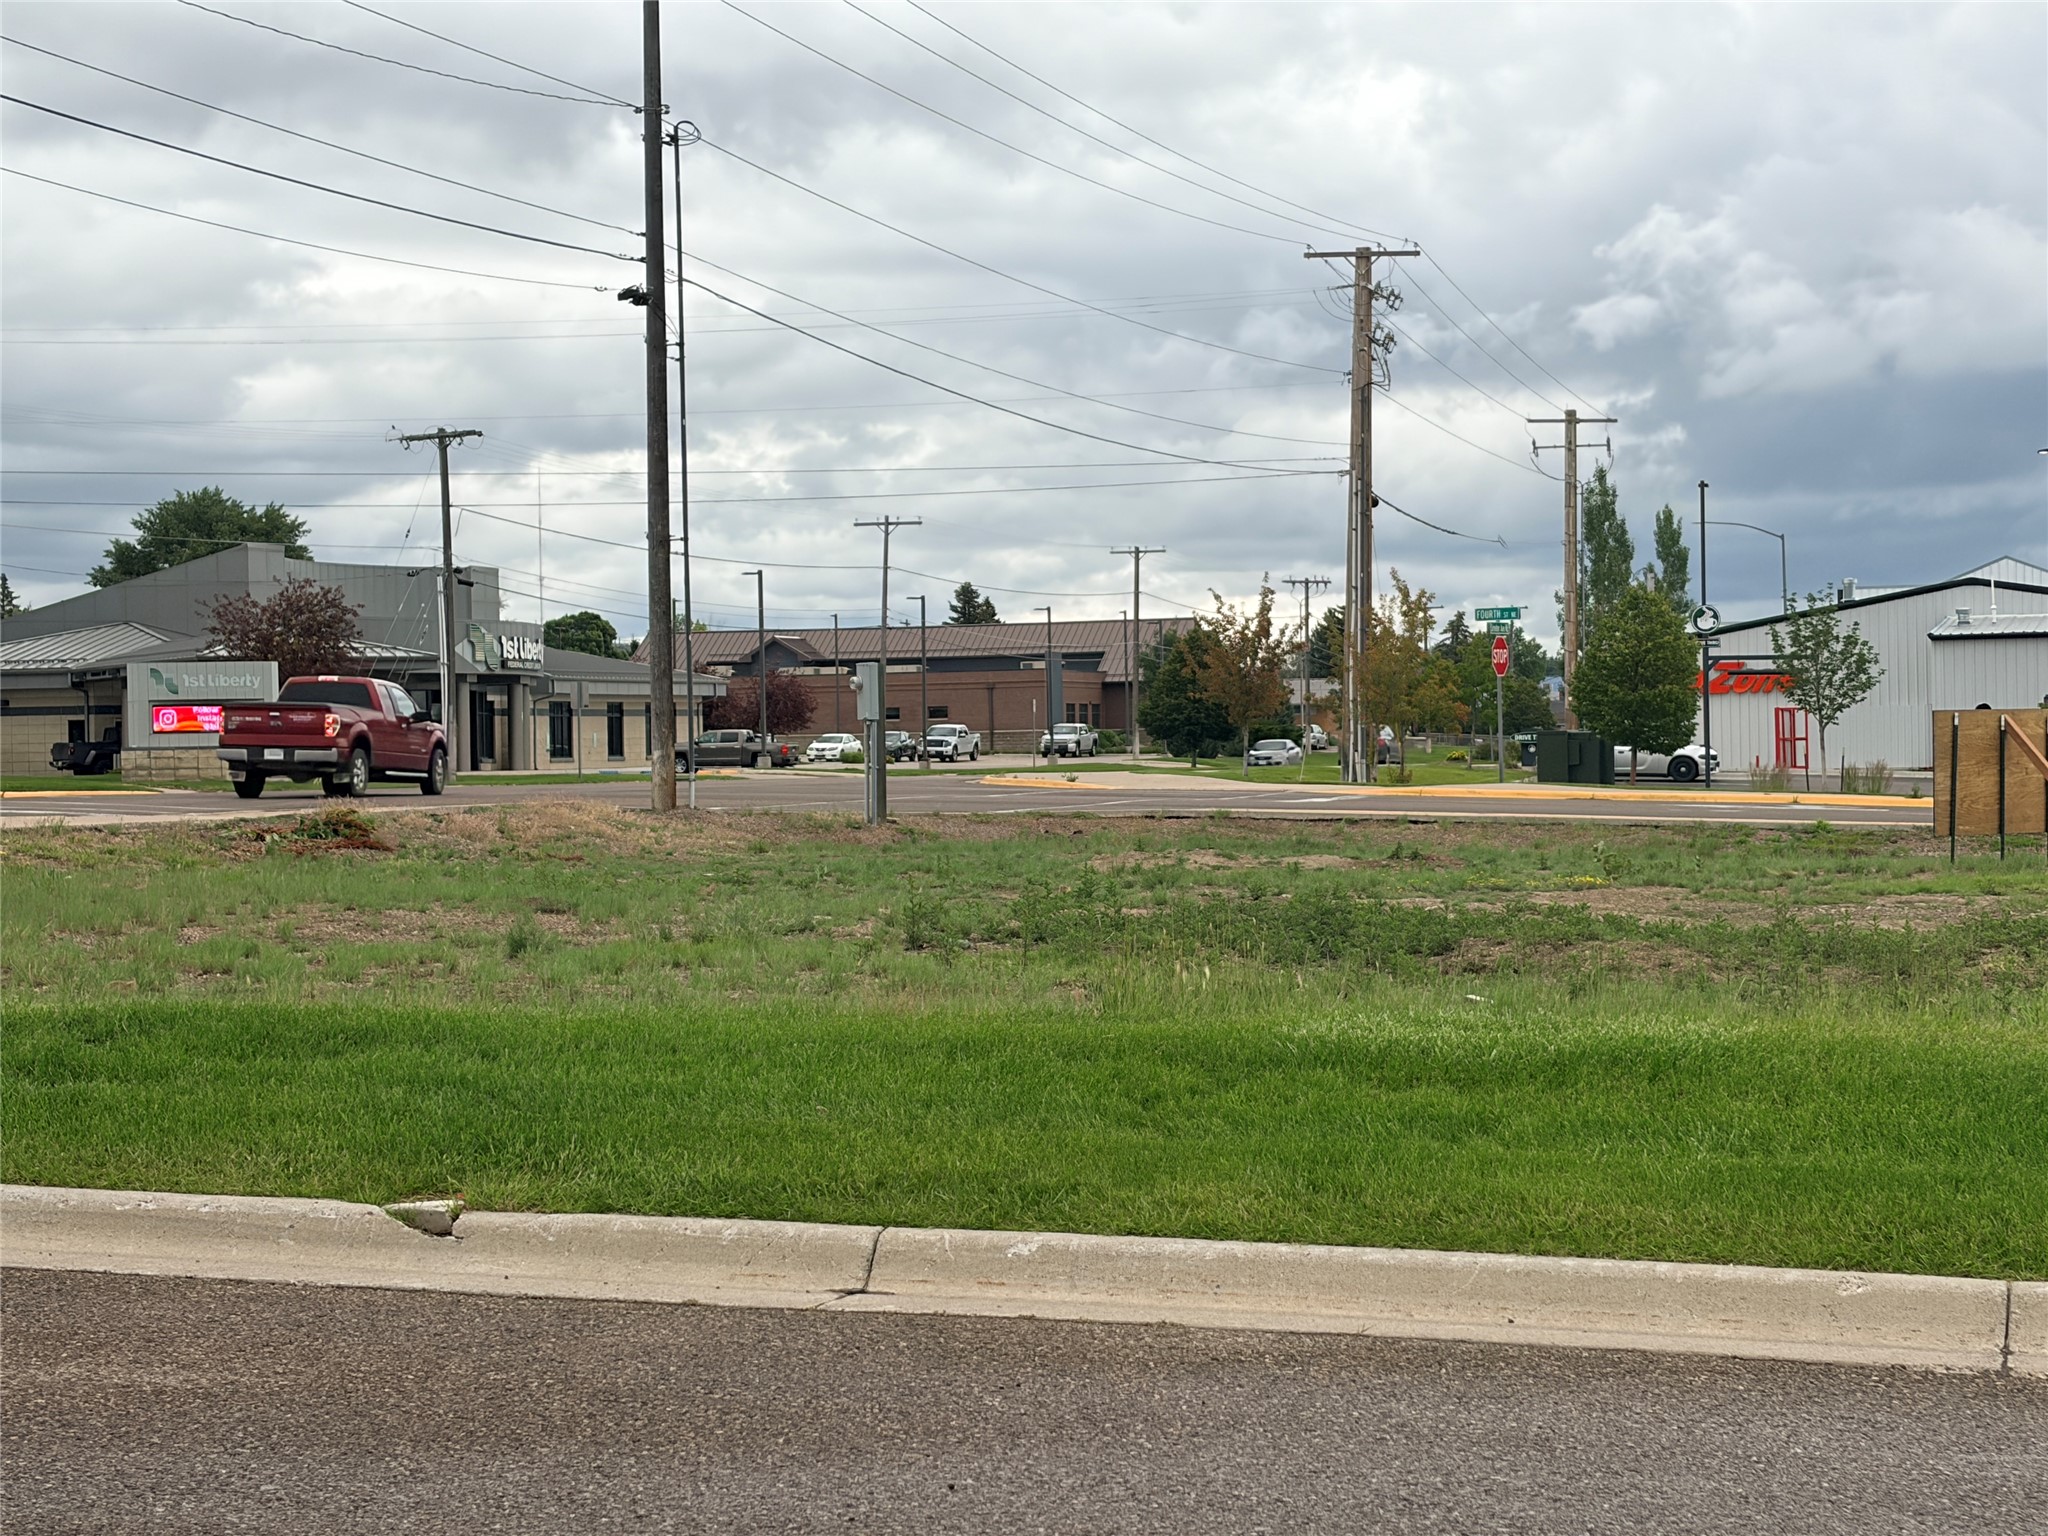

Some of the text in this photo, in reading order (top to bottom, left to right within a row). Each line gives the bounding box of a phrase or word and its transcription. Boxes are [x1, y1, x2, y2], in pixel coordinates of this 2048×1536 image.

[1476, 609, 1501, 619] FOURTH
[501, 635, 519, 660] 1st
[1493, 649, 1508, 664] STOP
[182, 673, 262, 689] 1st Liberty
